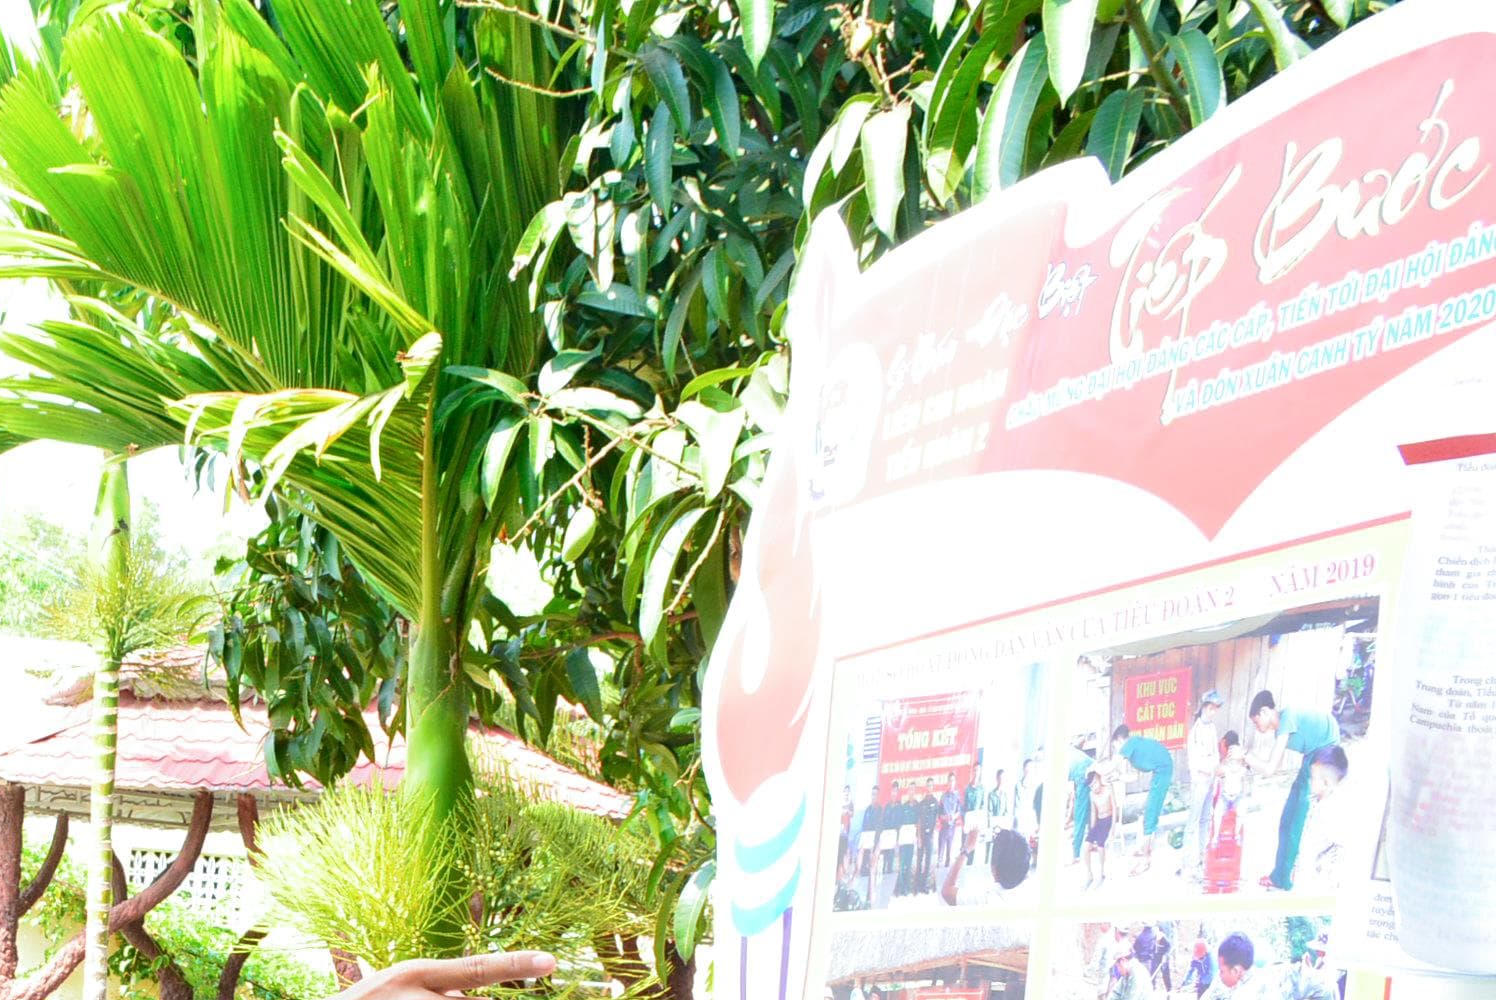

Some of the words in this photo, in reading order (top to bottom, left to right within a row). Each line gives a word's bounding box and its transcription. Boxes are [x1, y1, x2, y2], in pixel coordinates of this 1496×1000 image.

[1253, 79, 1491, 284] Bước
[1193, 321, 1229, 358] CÁC
[1279, 284, 1322, 330] TIẾN
[1365, 268, 1400, 301] ĐẠI
[1405, 243, 1442, 287] HỘI
[1449, 223, 1496, 267] ĐẢN
[1241, 354, 1292, 394] XUÂN
[1295, 335, 1349, 377] CANH
[1438, 288, 1496, 329] 2020
[1223, 586, 1235, 607] 2
[1326, 553, 1375, 585] 2019
